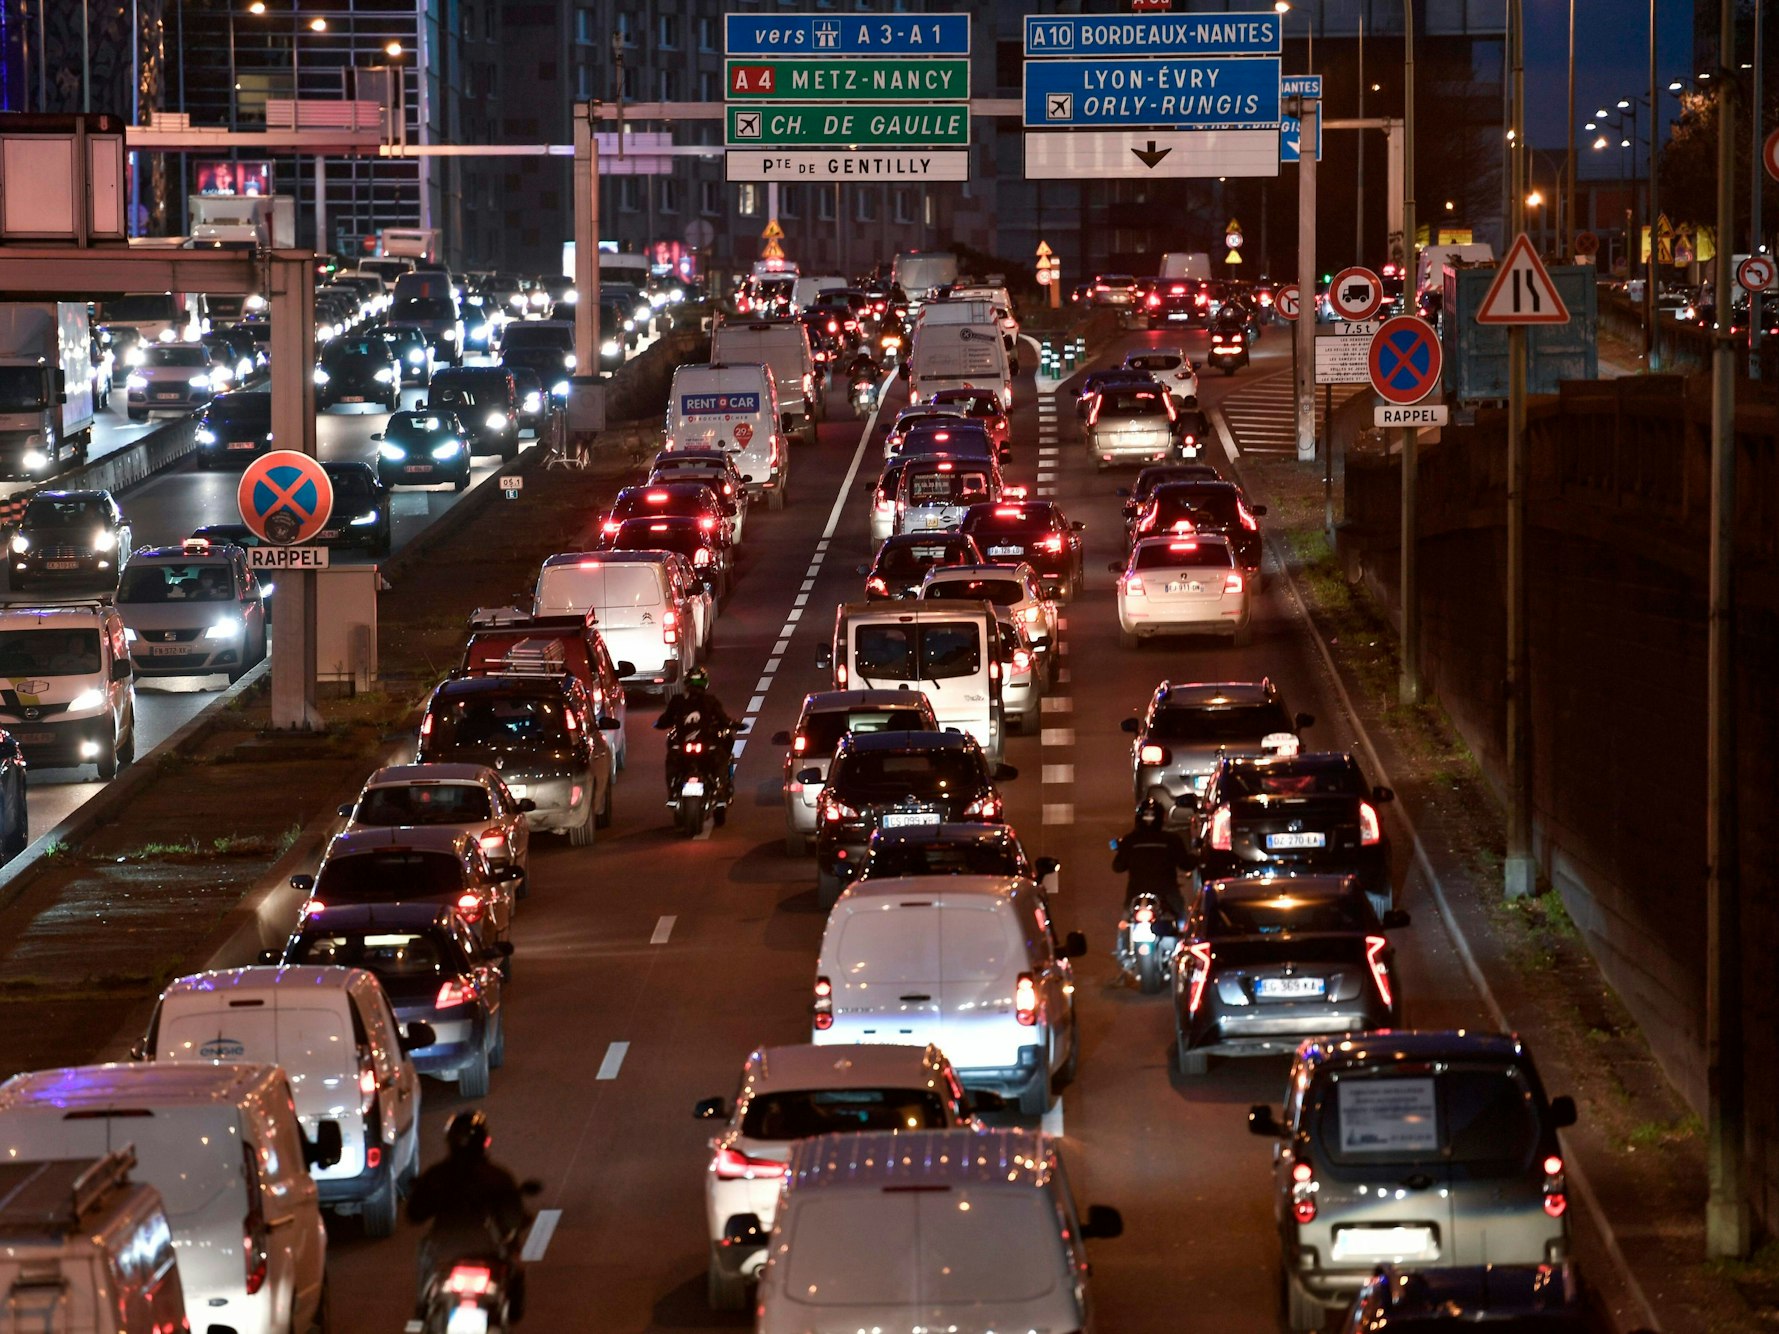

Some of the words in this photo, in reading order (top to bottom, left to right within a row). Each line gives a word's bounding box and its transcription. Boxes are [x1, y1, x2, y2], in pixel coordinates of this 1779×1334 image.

[755, 28, 805, 44] vers
[1080, 22, 1274, 46] BORDEAUX-NANTES
[792, 69, 953, 90] METZ-NANCY
[1083, 65, 1220, 90] LYON-ÉVRY
[1083, 94, 1260, 116] ORLY-RUNGIS
[770, 115, 808, 135] CH.
[823, 115, 855, 135] DE
[870, 115, 961, 135] GAULLE
[799, 163, 816, 174] DE
[828, 158, 932, 174] GENTILLY
[1344, 323, 1362, 334] 7.5
[1365, 324, 1371, 334] t
[687, 398, 717, 409] RENT
[729, 397, 754, 408] CAR
[1384, 410, 1438, 422] RAPPEL
[252, 550, 323, 566] RAPPEL
